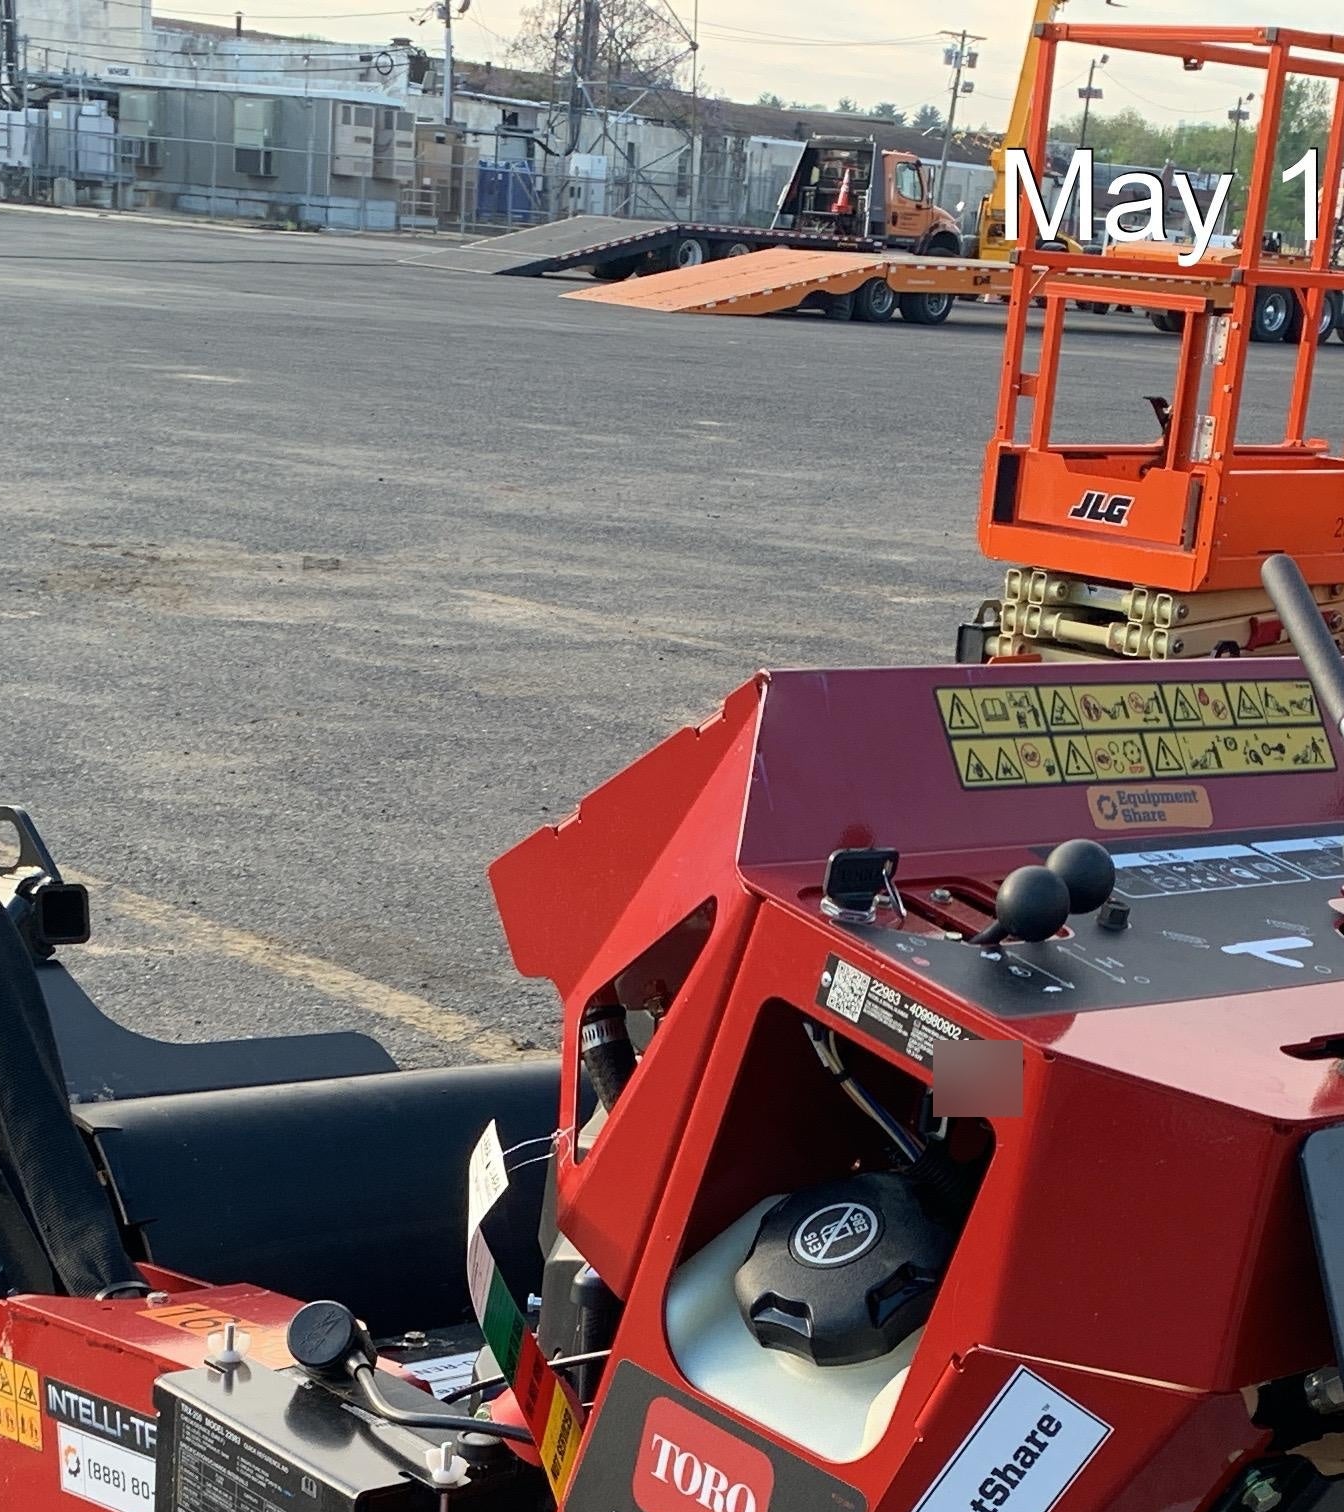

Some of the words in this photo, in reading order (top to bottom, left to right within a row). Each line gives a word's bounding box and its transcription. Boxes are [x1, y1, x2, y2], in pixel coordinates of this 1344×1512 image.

[1068, 490, 1136, 527] JLG
[1116, 788, 1200, 810] Equipment
[1120, 806, 1168, 824] Share
[869, 979, 902, 1006] 22983
[850, 1212, 870, 1234] E85
[803, 1231, 823, 1255] E15
[87, 1457, 127, 1493] (888)
